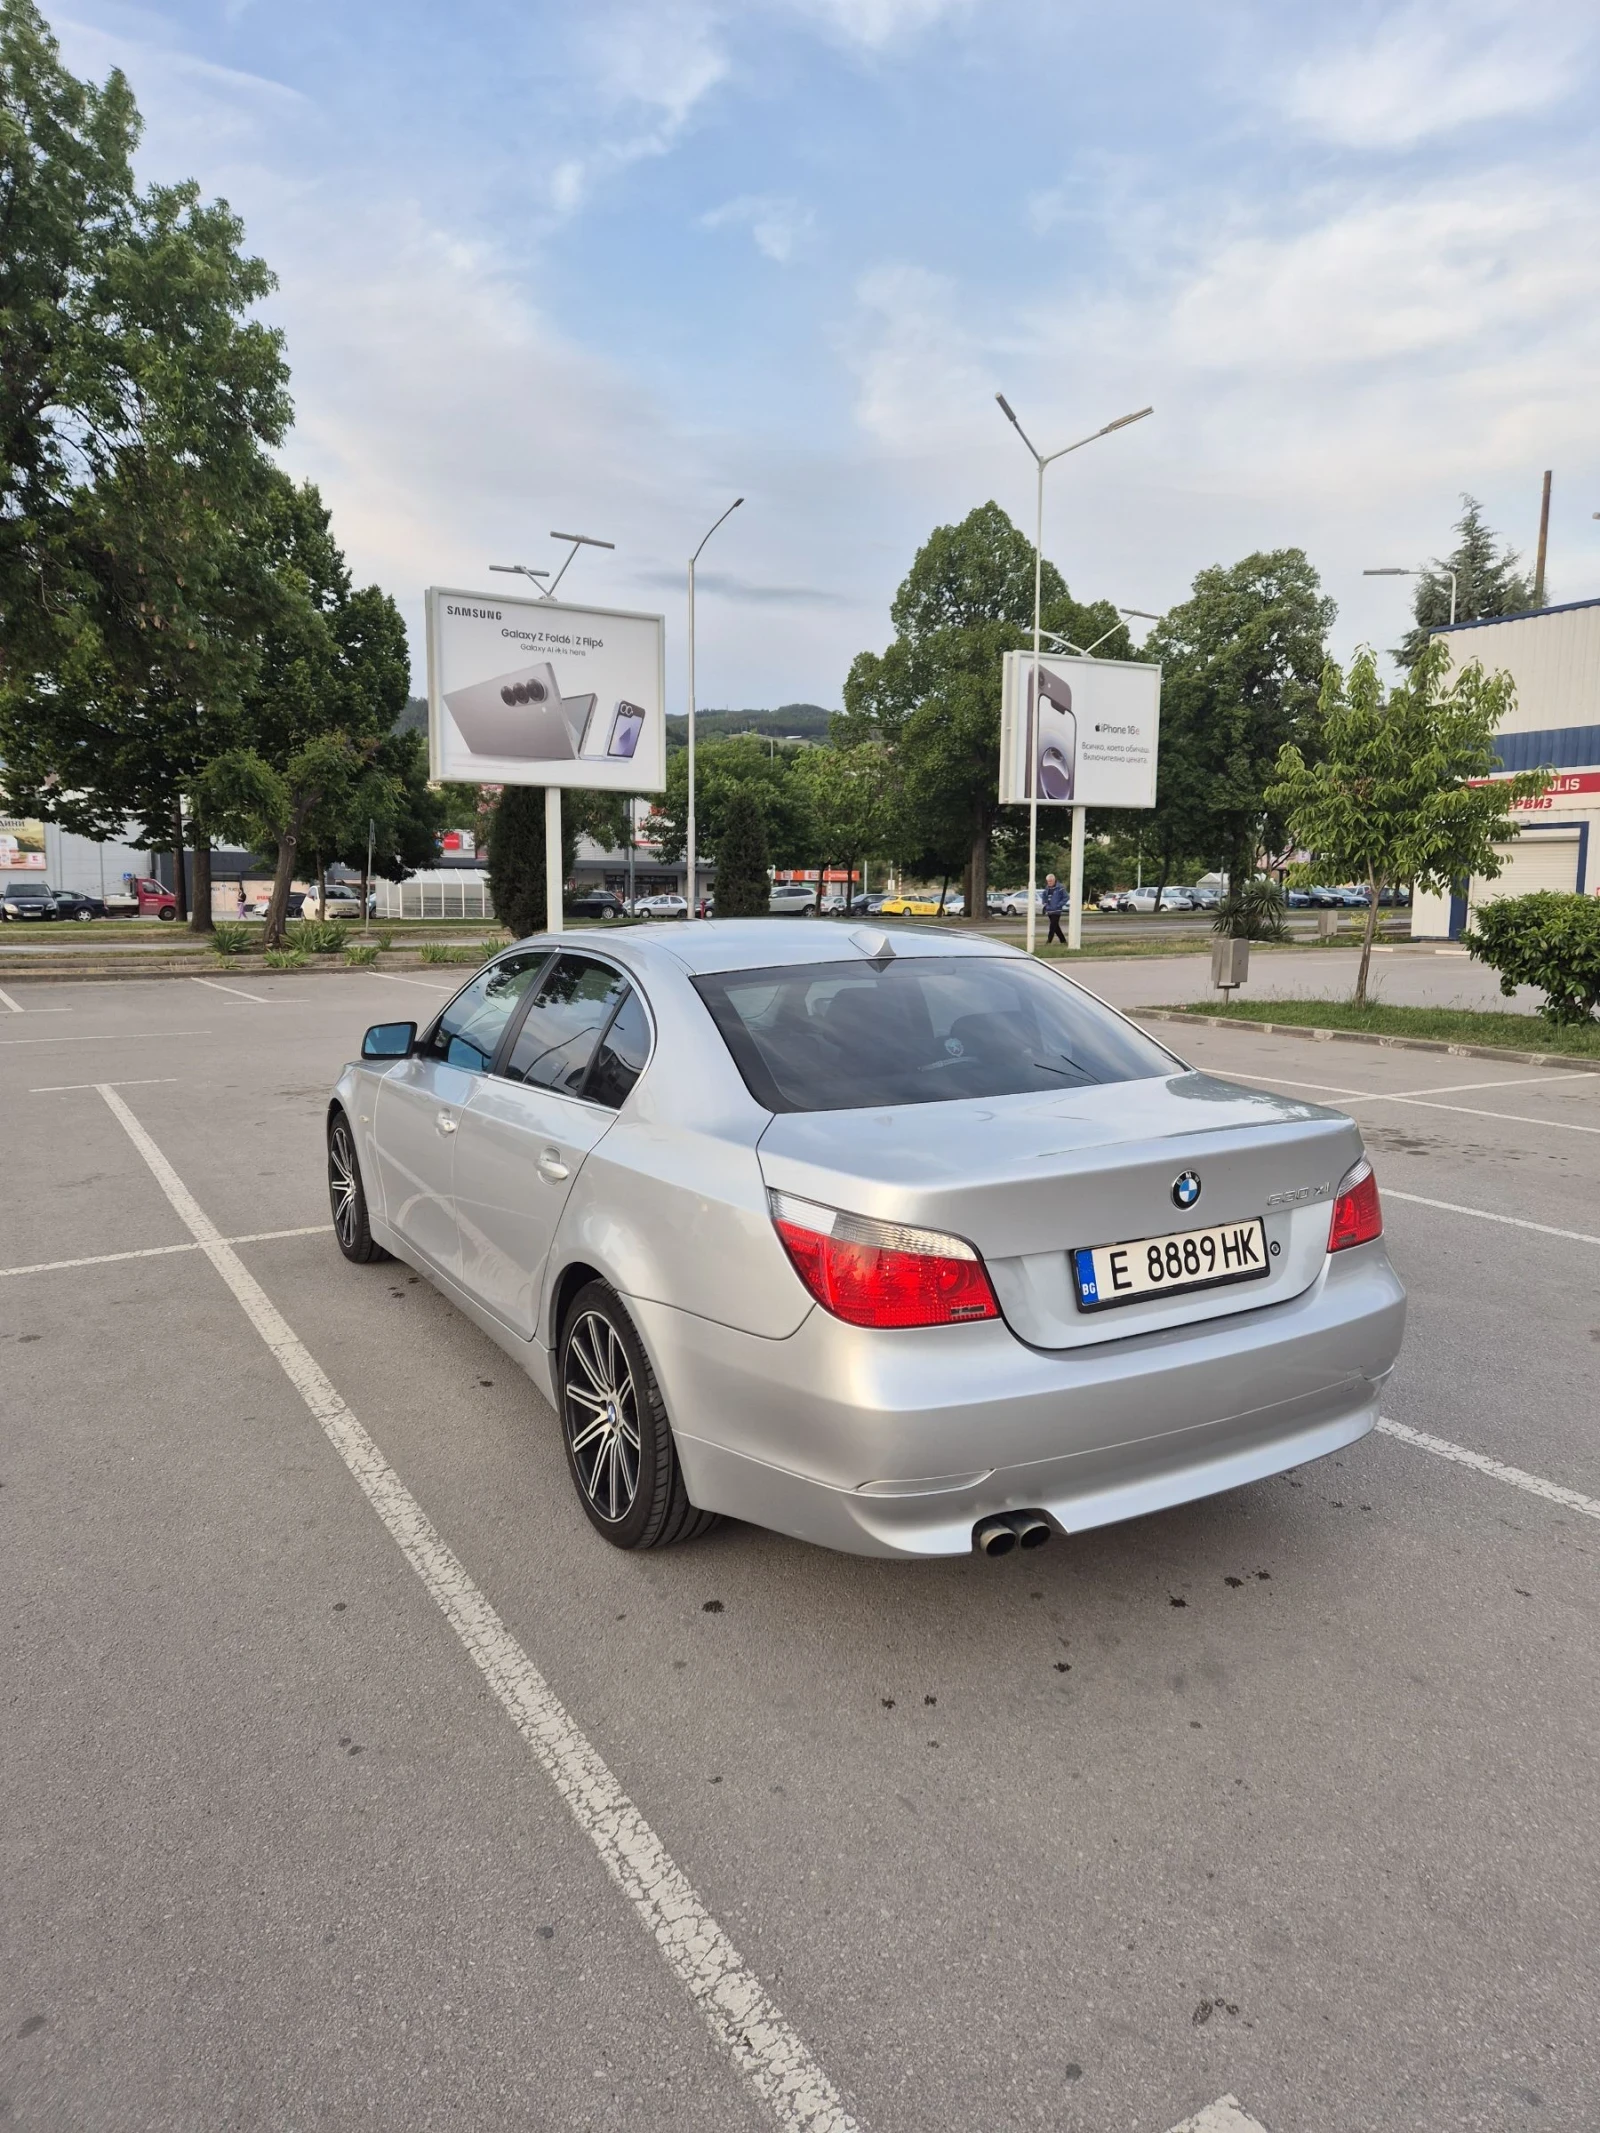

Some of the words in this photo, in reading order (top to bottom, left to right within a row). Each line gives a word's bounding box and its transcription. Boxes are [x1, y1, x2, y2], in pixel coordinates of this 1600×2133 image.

[447, 605, 502, 620] SAMSUNG
[501, 628, 537, 642] Galaxy
[538, 632, 544, 642] Z
[545, 633, 571, 644] Fold6
[575, 636, 581, 645] Z
[582, 637, 604, 649] Flip6
[520, 643, 546, 653] Galaxy
[570, 648, 586, 656] here
[1100, 723, 1127, 735] iPhone
[1127, 725, 1140, 736] 16e
[1109, 1250, 1132, 1291] E
[1147, 1235, 1216, 1283] 8889
[1220, 1227, 1260, 1269] HK
[1082, 1282, 1096, 1296] BG
